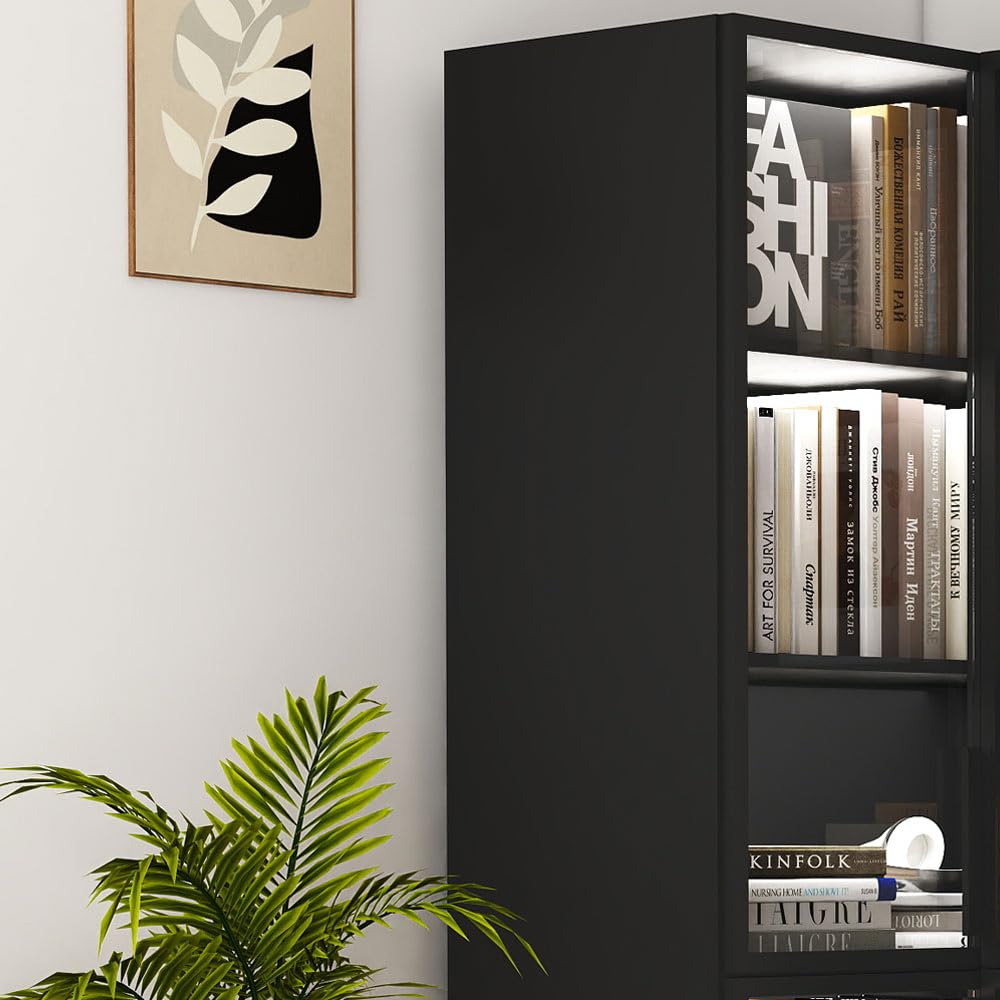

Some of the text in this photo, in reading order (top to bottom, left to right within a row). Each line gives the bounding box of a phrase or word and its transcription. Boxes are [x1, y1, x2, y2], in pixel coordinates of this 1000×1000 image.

[873, 186, 883, 330] Уличный кот по имени Боб
[893, 137, 906, 323] БОЖЕСТВЕННАЯ КОМЕДИЯ РАЙ
[871, 447, 879, 473] Стив
[871, 475, 879, 513] Джобс
[763, 509, 774, 641] ART FOR SURVIVAL
[904, 518, 918, 622] Мартин Иден
[950, 480, 961, 599] К ВЕЧНОМУ МИРУ
[803, 564, 816, 626] Спартак
[931, 550, 941, 631] ТРАКТАТЫ
[750, 854, 851, 870] KINFOLK
[751, 889, 782, 898] NURSING
[782, 888, 802, 897] HOME
